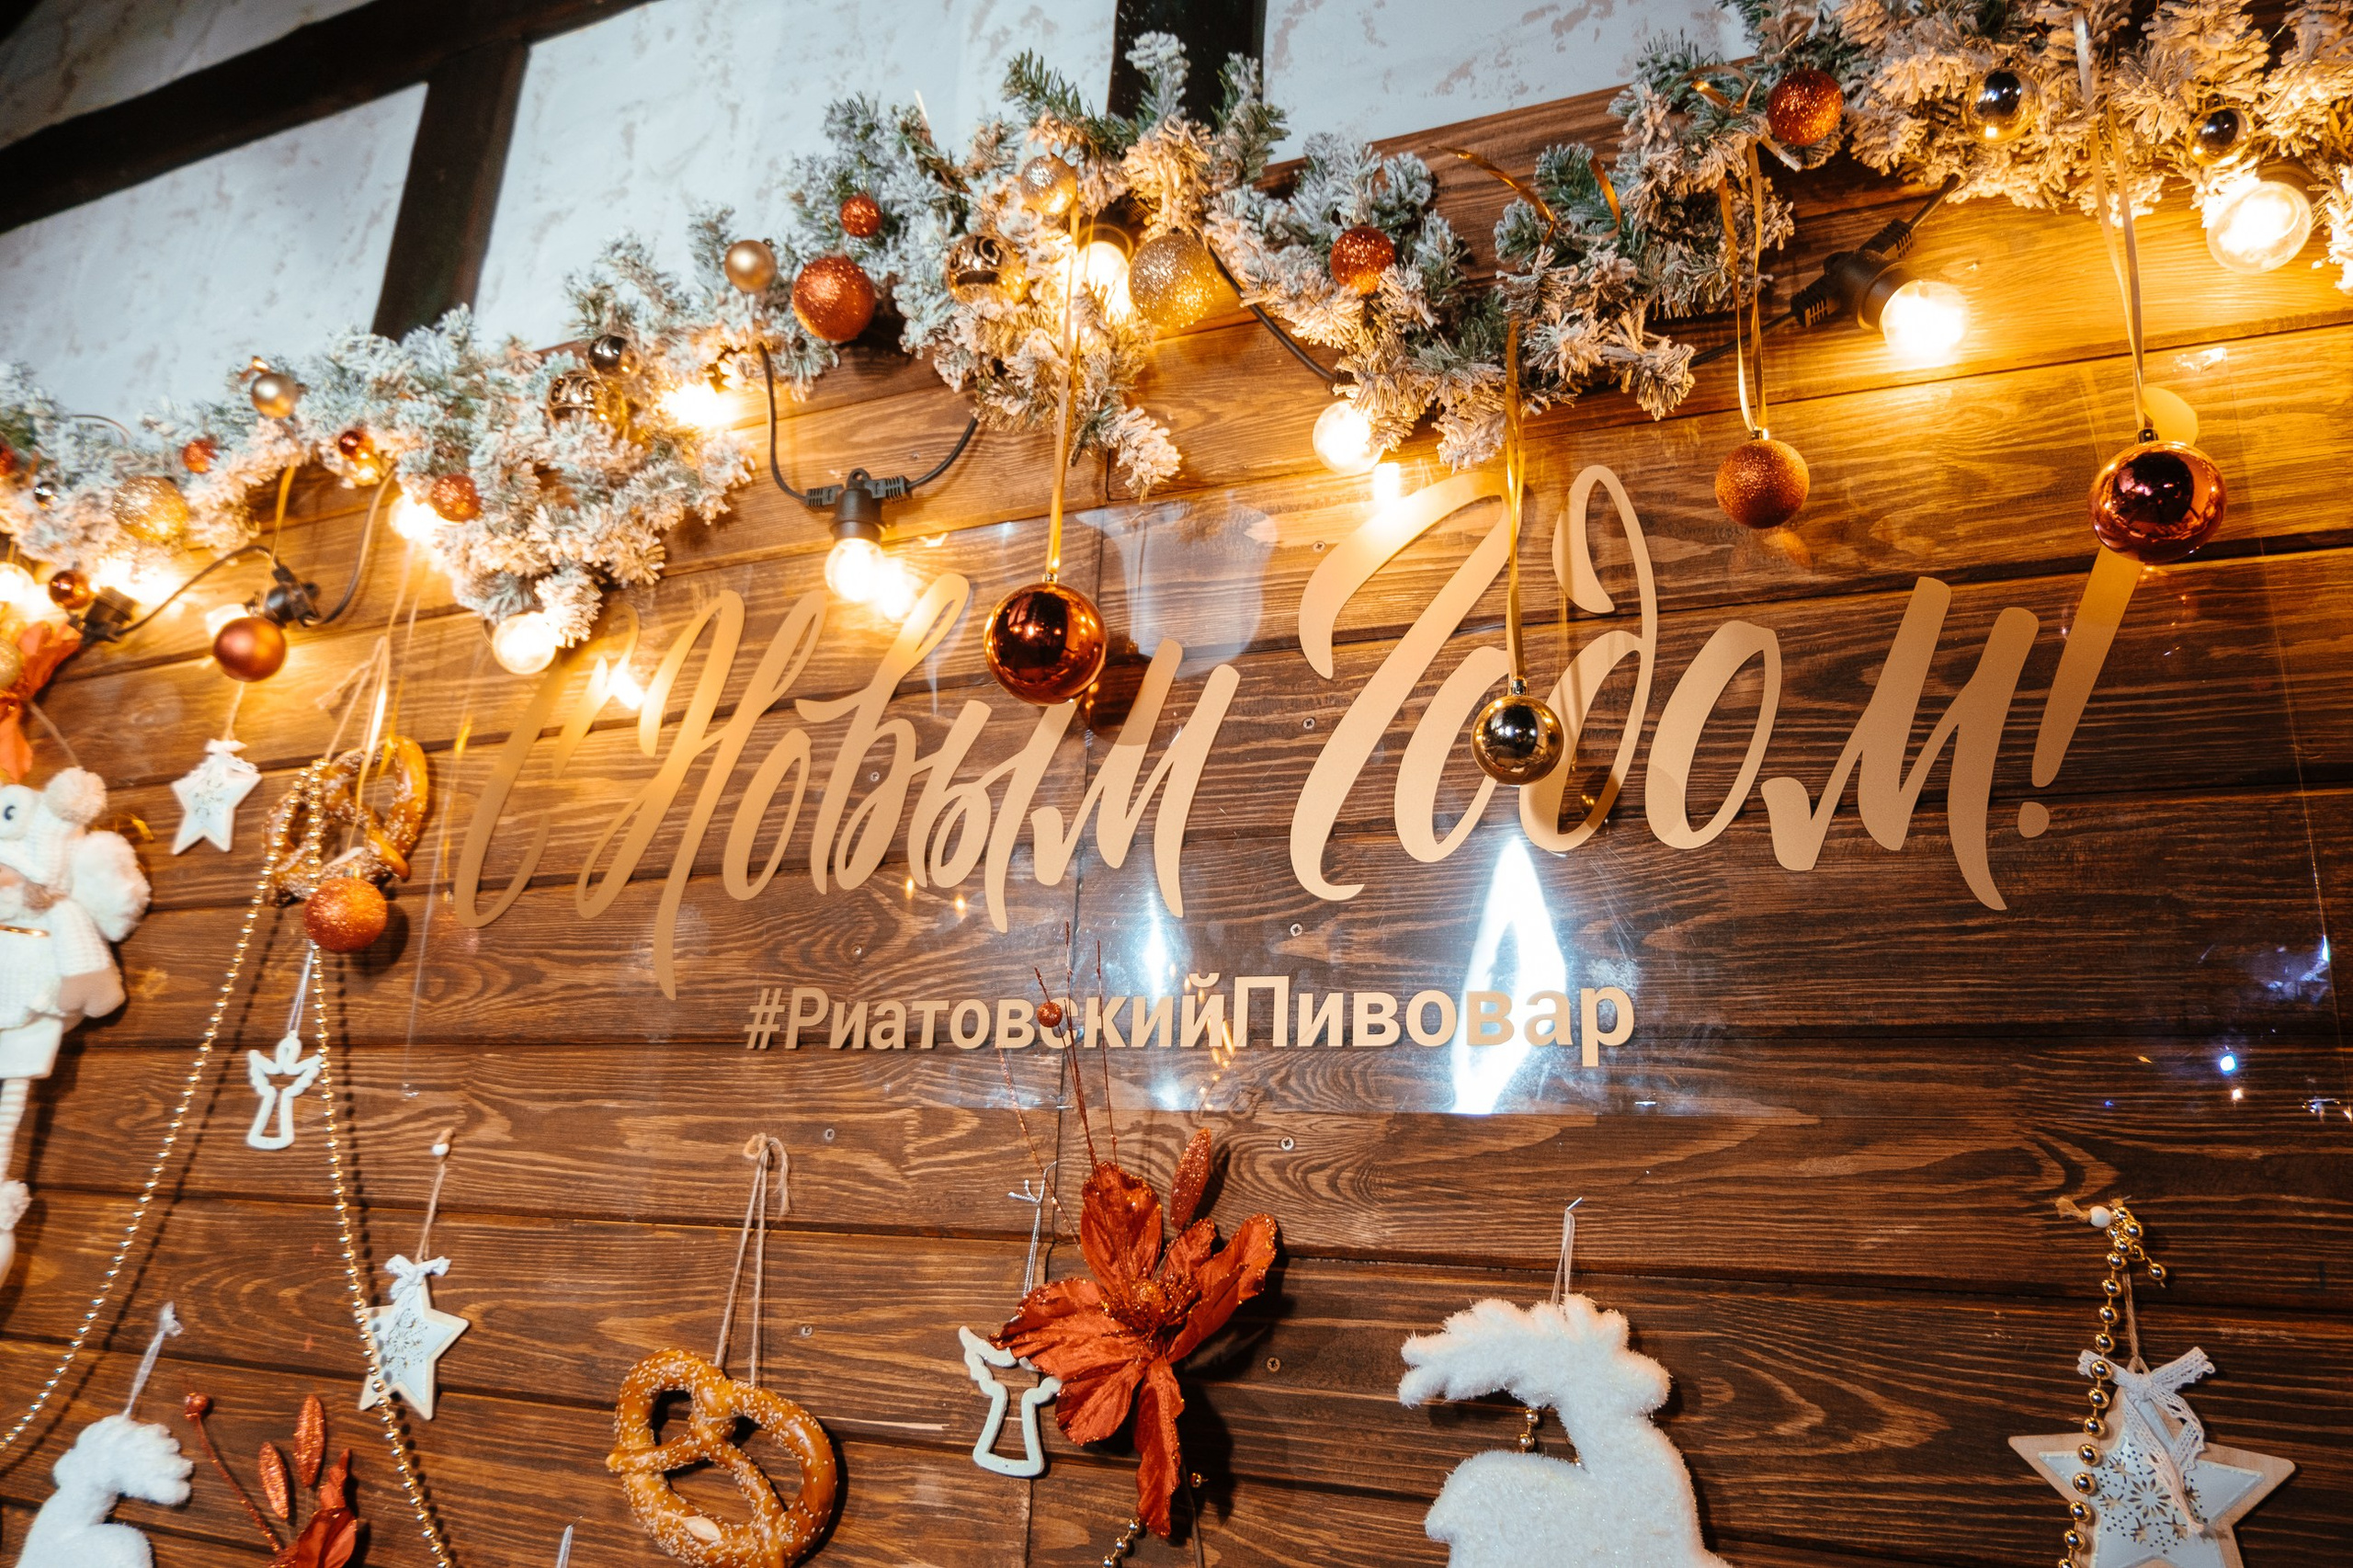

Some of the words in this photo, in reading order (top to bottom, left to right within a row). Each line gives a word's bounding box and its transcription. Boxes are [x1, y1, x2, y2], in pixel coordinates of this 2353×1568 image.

[454, 602, 641, 928] С
[575, 573, 1239, 1001] Новым
[1290, 386, 2198, 912] Годом!
[744, 971, 1635, 1067] #РиатовскийПивовар
